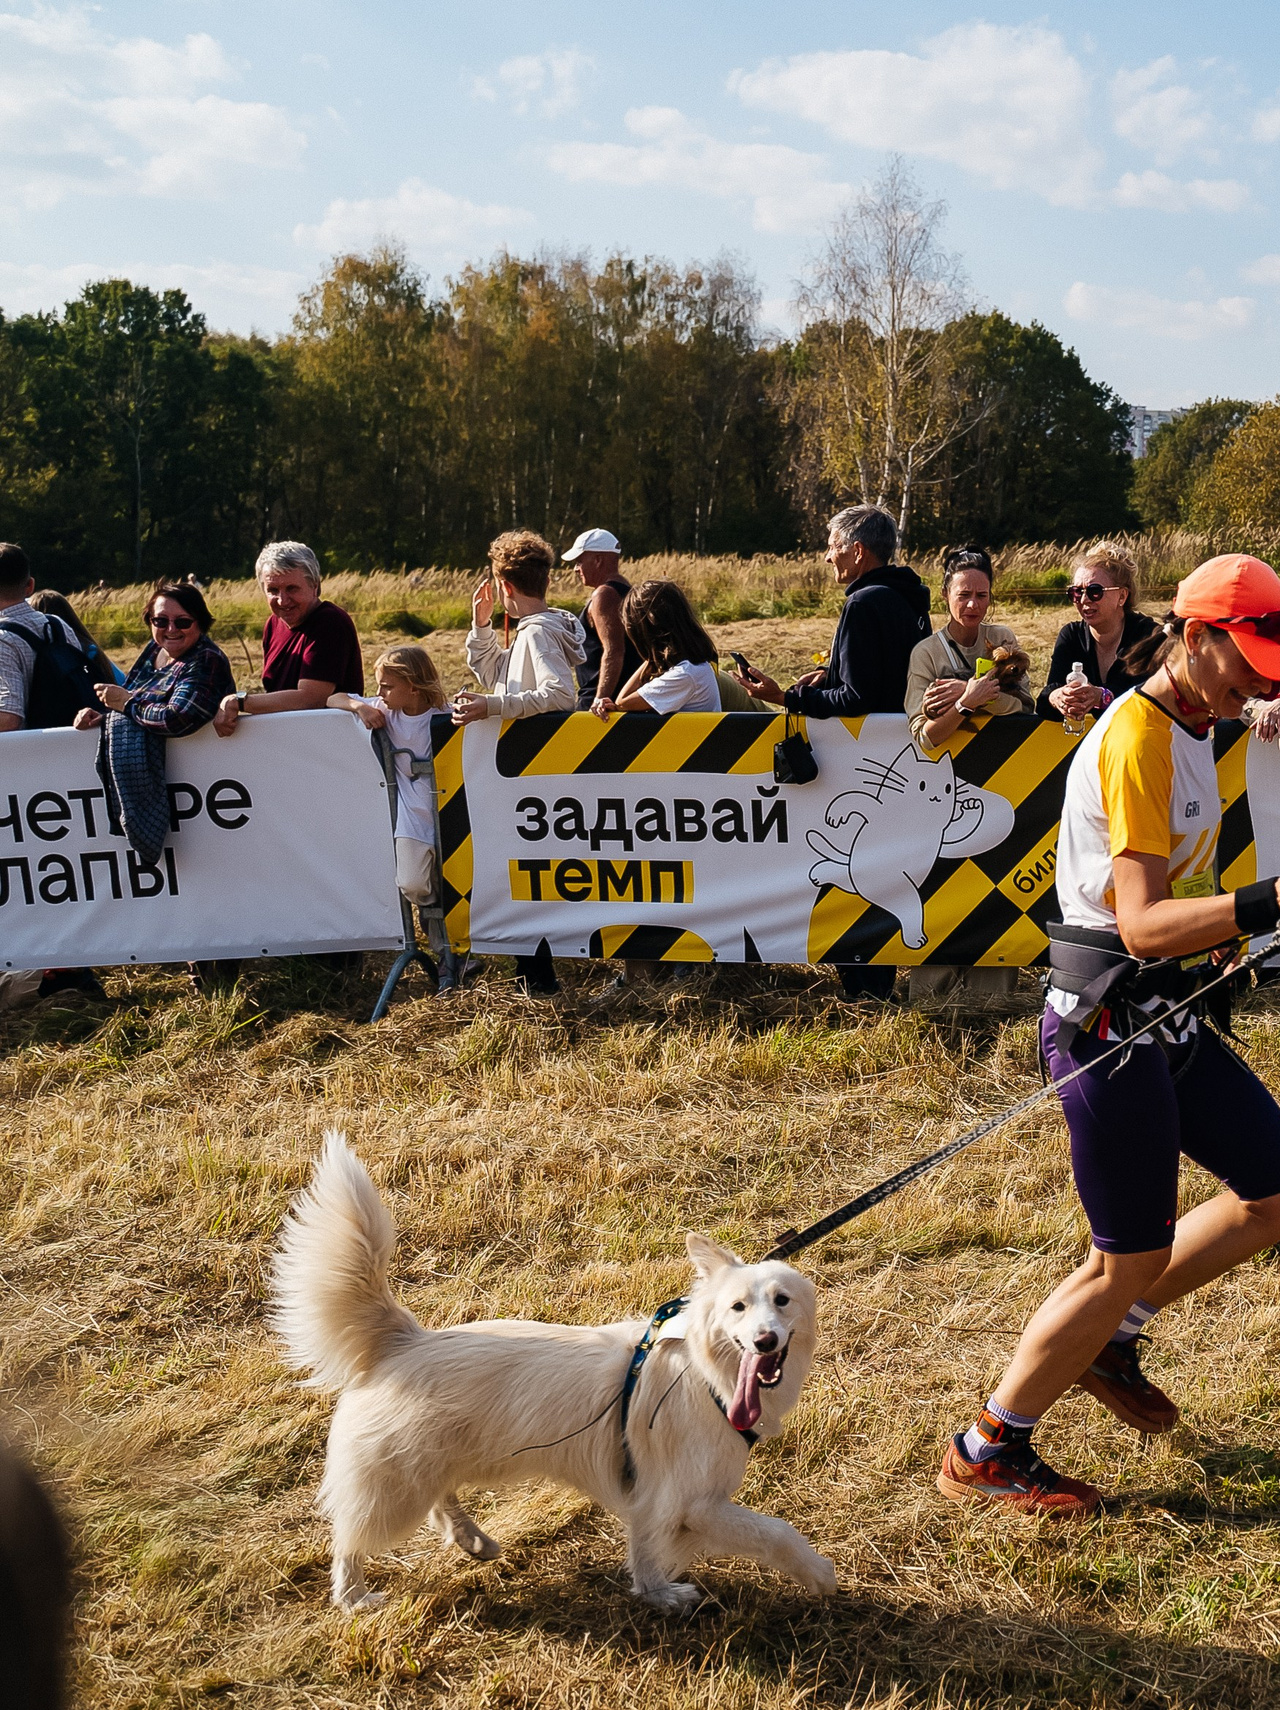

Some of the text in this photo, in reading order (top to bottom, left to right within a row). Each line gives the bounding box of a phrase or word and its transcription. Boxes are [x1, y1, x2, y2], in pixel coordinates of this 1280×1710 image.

[0, 779, 252, 843] четре
[515, 785, 789, 851] задавай
[0, 847, 179, 907] лапы
[517, 858, 685, 902] темп
